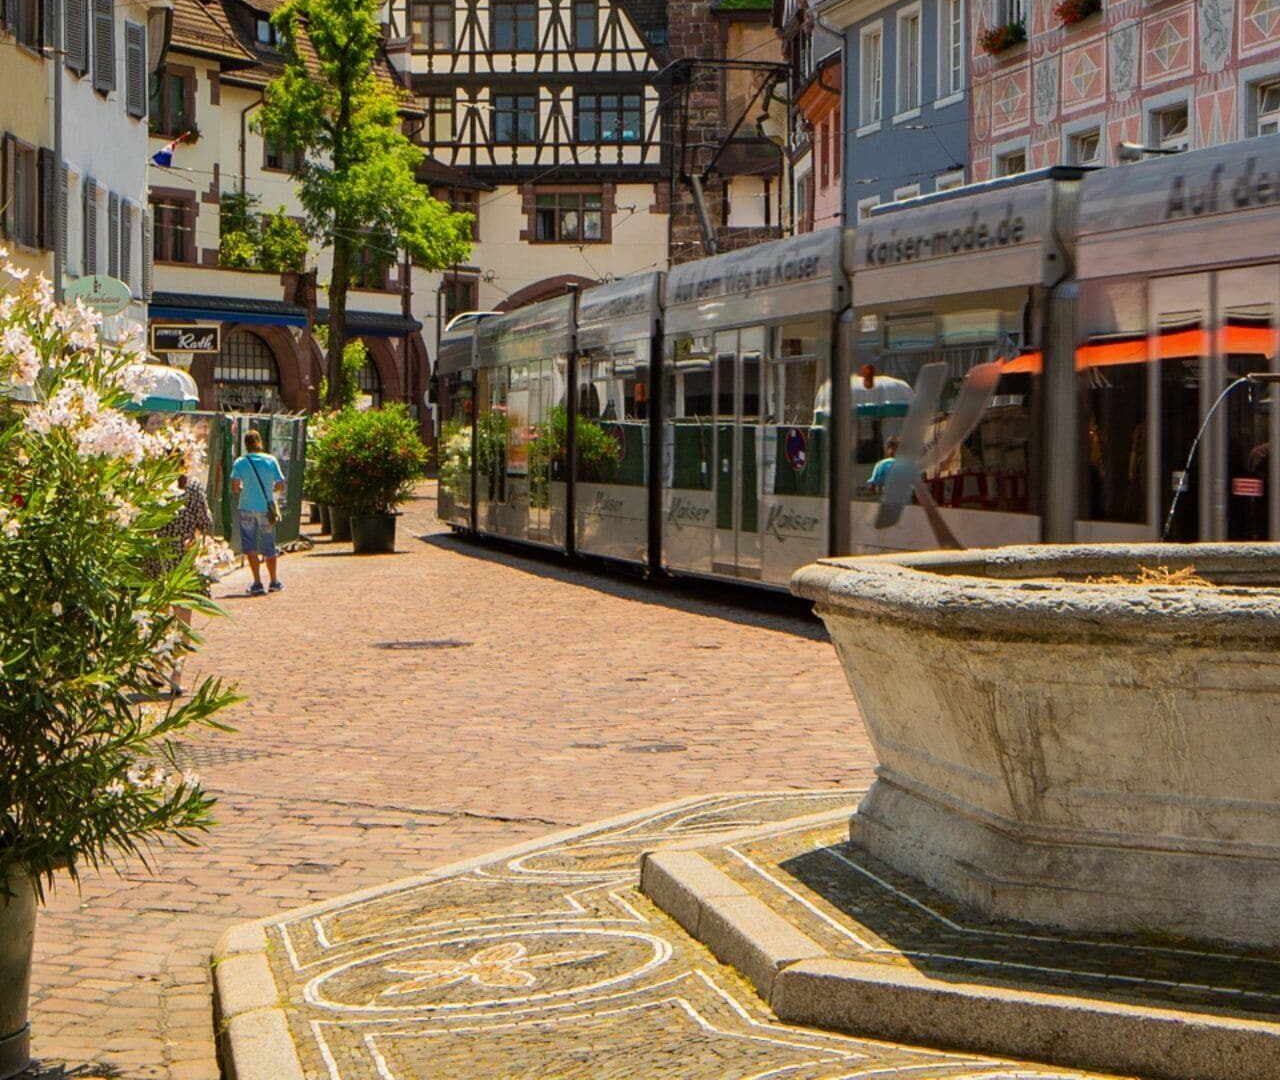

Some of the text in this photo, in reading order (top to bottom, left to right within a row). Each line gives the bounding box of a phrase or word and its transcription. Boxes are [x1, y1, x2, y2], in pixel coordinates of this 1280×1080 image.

[1165, 163, 1225, 219] Auf
[866, 202, 1025, 267] kaiser-mode.de
[178, 333, 215, 350] Rath
[667, 494, 710, 531] Kaiser
[765, 502, 820, 543] Kaiser
